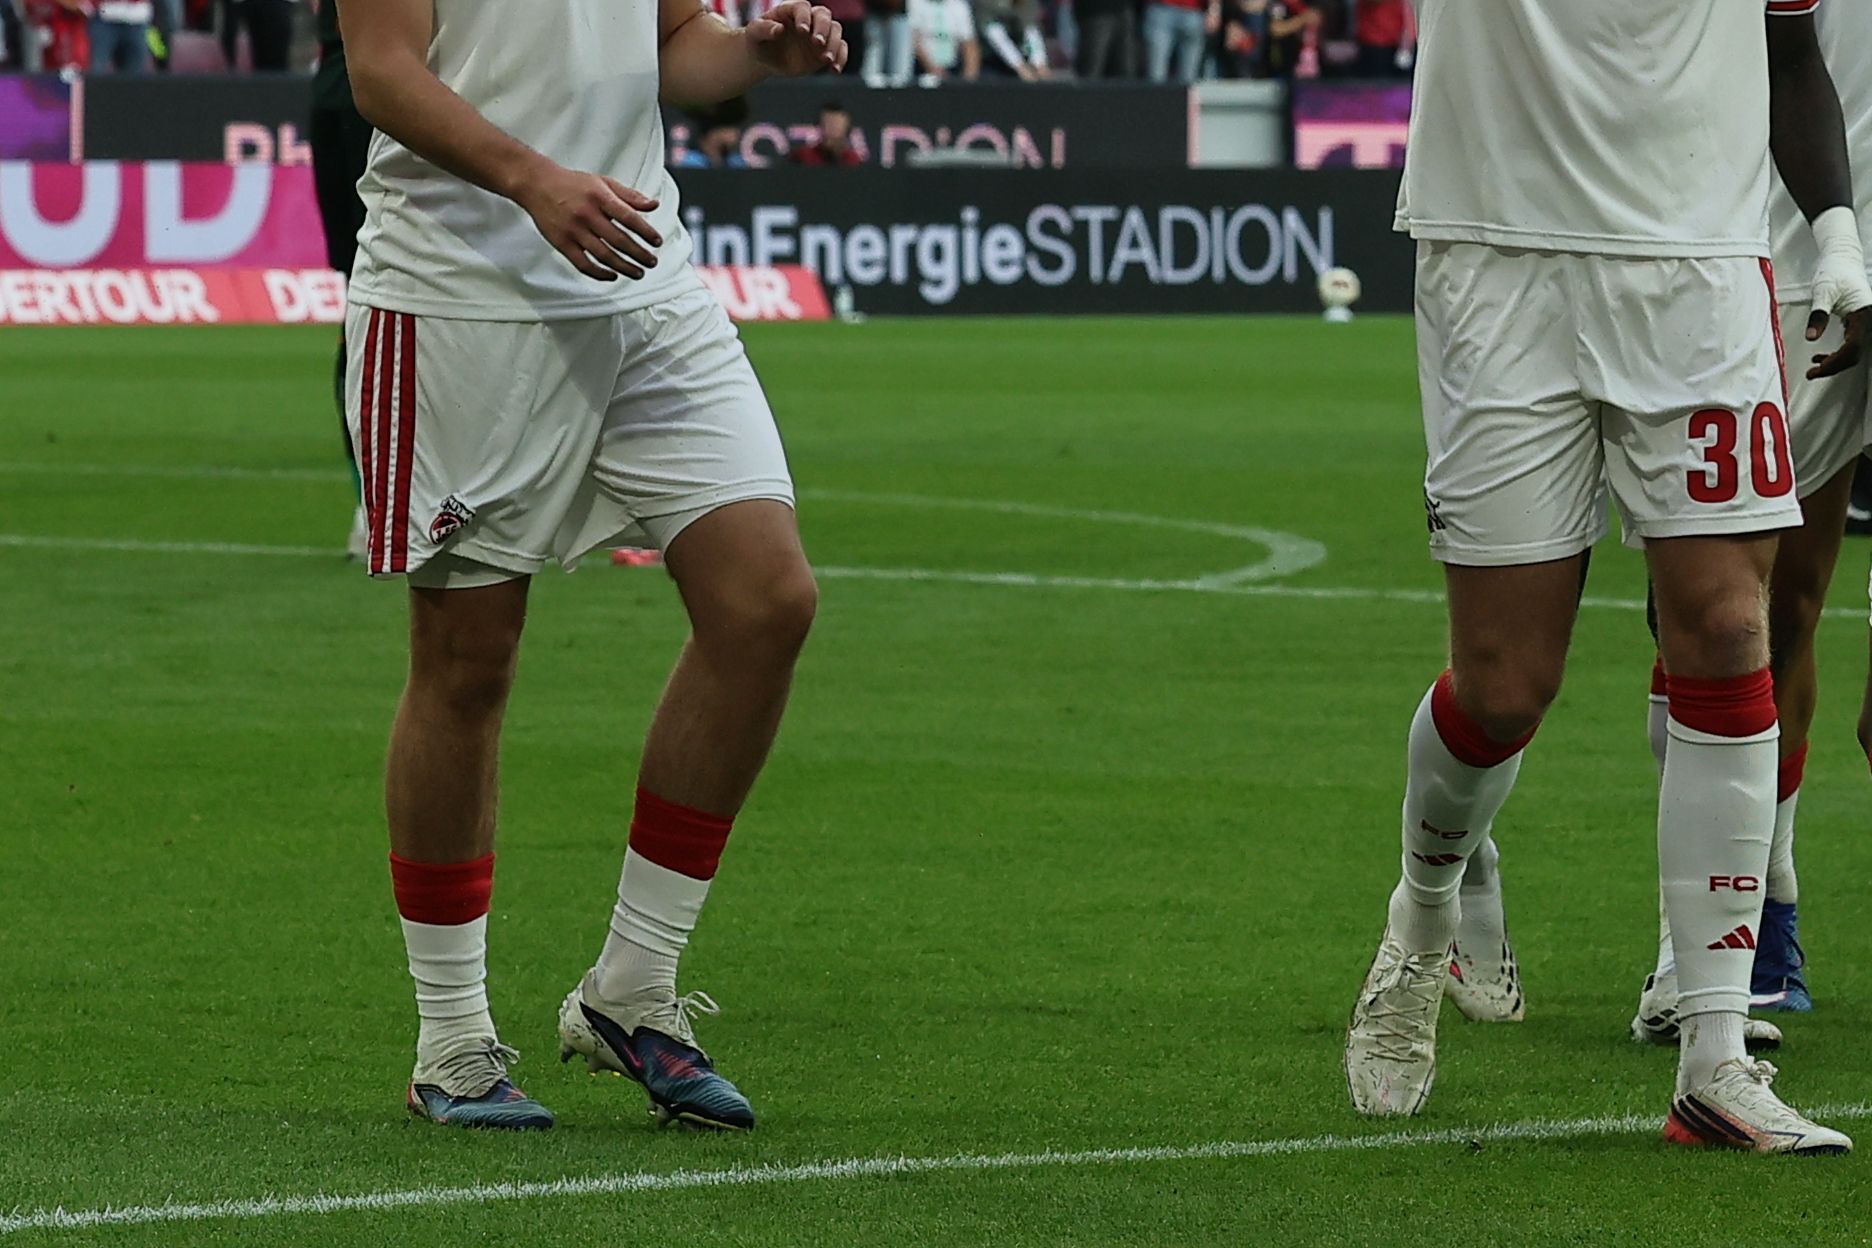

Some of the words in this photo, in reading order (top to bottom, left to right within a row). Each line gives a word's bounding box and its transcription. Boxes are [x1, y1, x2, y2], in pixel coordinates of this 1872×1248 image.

[683, 206, 1333, 304] inEnergieSTADION
[0, 269, 219, 323] ERTOUR
[1687, 401, 1793, 504] 30
[1709, 875, 1759, 893] FC
